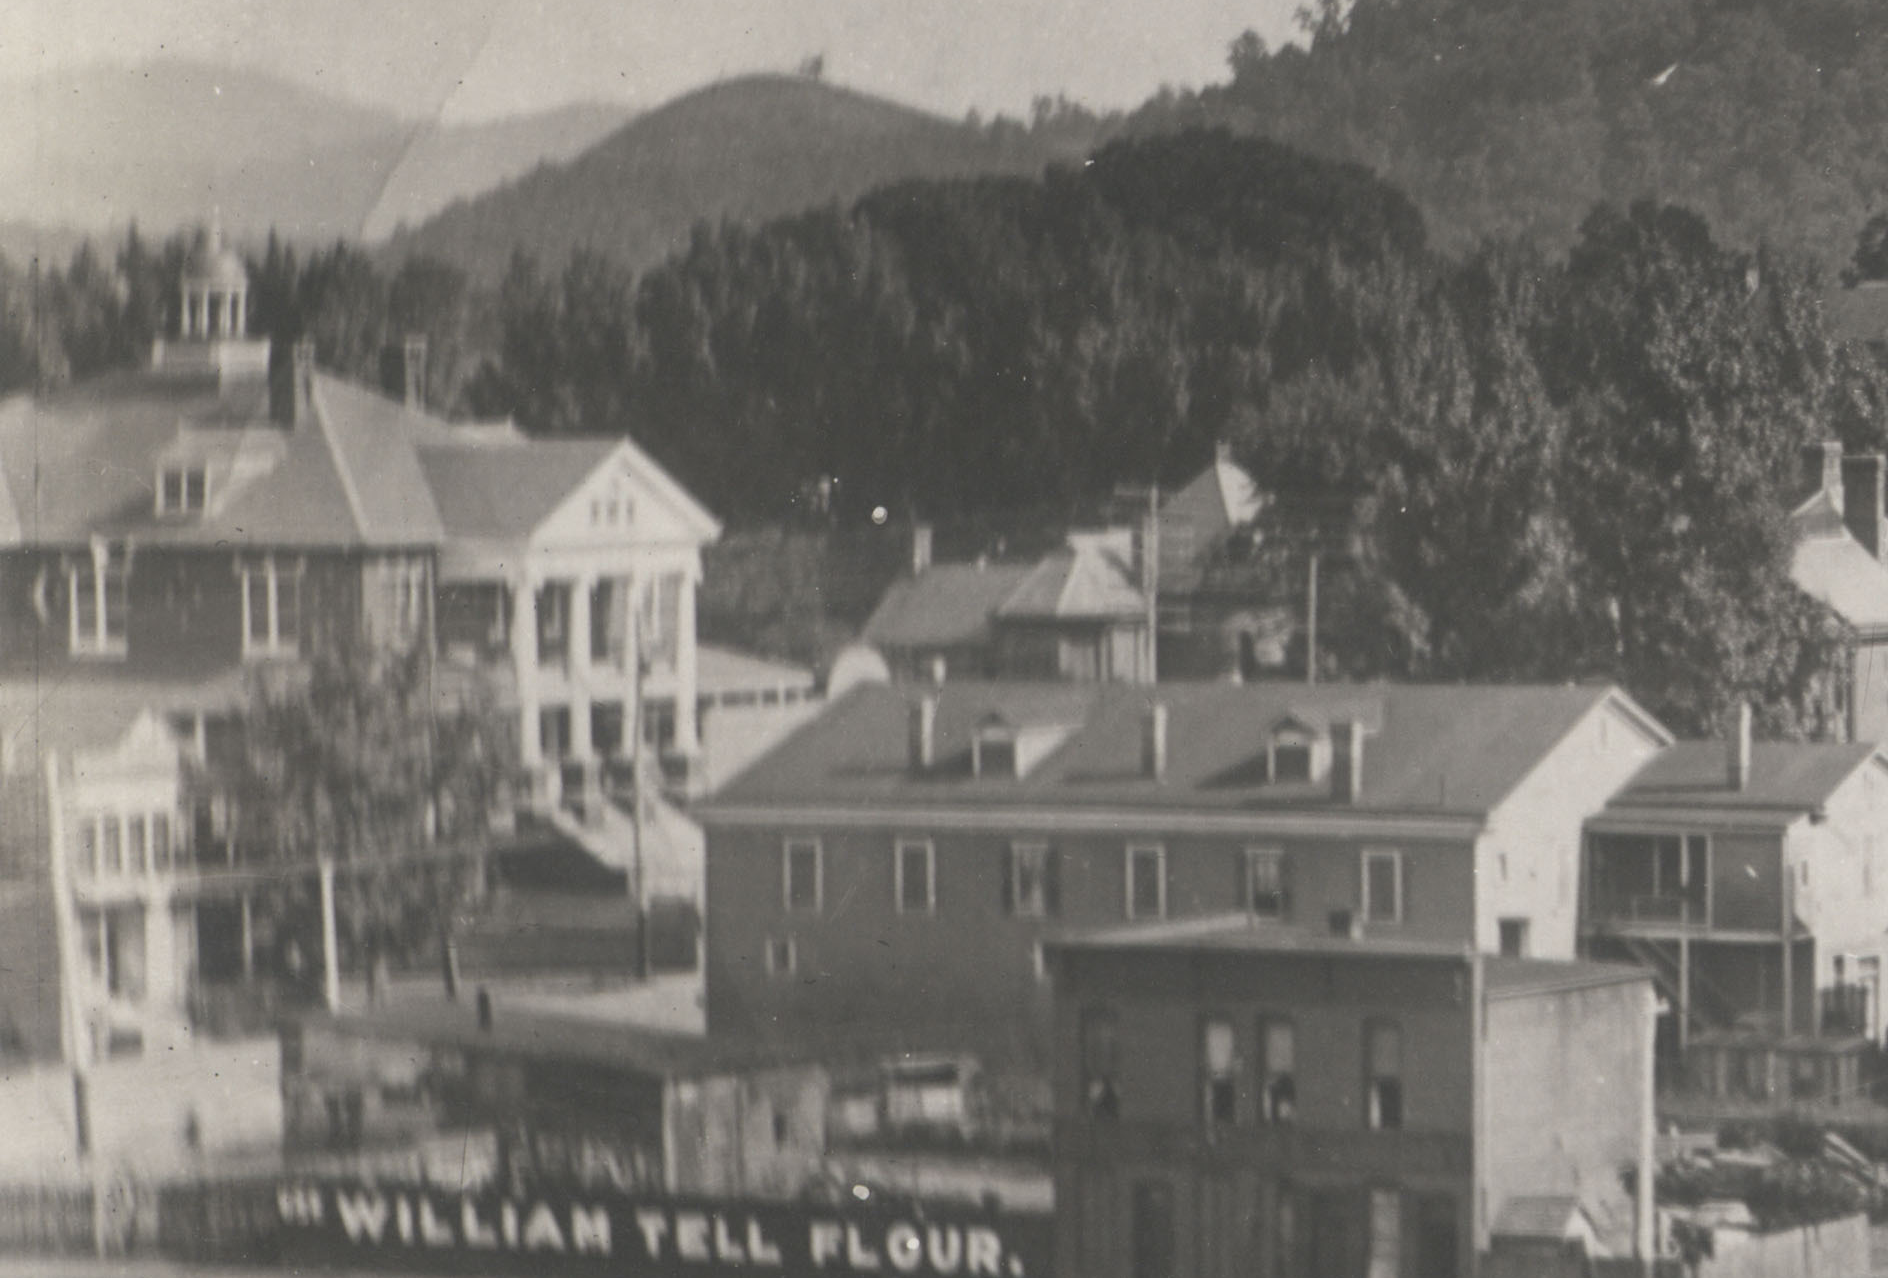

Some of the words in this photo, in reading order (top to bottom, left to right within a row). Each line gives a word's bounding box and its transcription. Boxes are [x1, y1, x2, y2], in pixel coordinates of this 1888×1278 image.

[337, 1189, 612, 1255] WILLIAM
[633, 1210, 782, 1267] TELL
[810, 1222, 1026, 1278] FLOUR.
